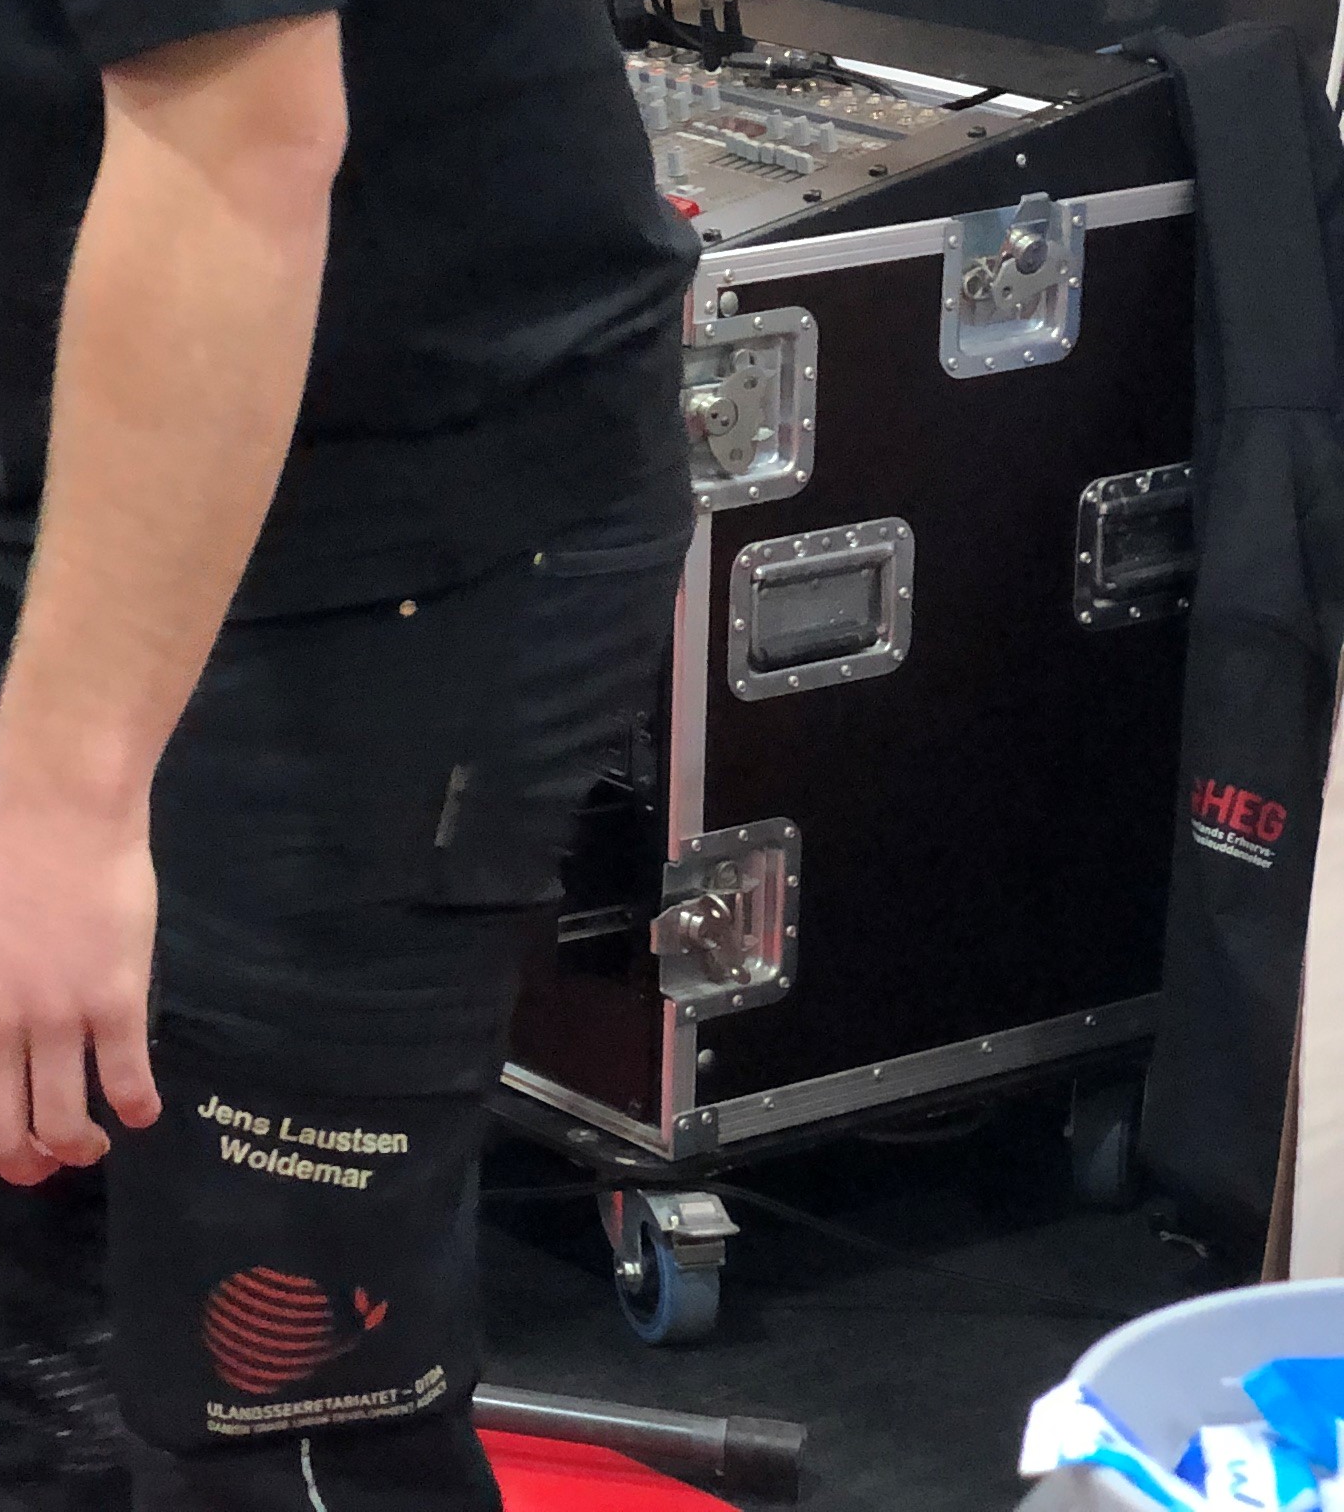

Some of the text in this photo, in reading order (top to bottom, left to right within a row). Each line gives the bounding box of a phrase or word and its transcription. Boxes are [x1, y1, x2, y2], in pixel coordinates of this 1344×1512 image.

[197, 1094, 410, 1154] Jens Laustsen
[220, 1134, 374, 1189] Woldemar
